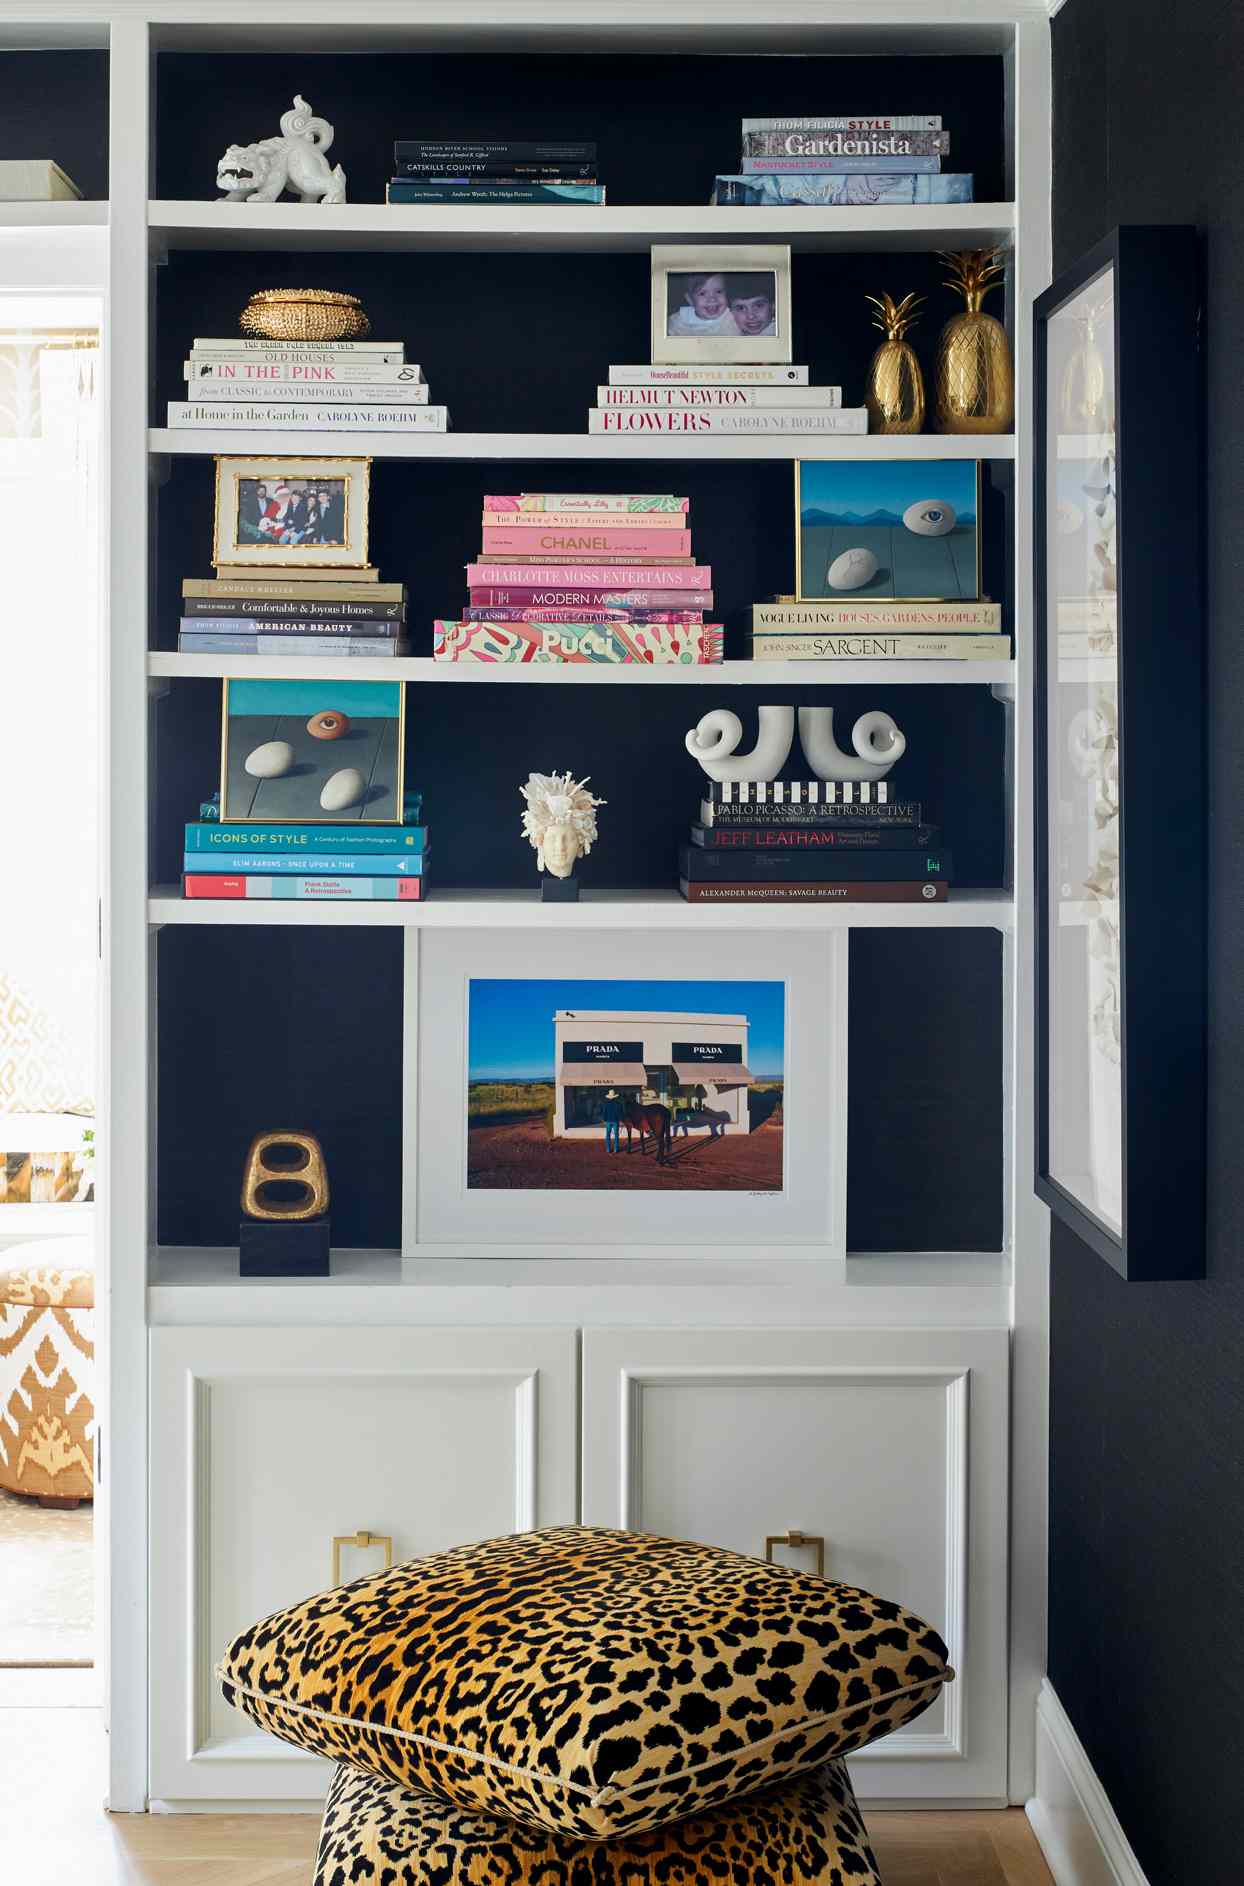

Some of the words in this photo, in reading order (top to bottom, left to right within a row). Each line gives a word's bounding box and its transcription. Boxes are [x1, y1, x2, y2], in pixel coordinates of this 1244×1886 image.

[848, 120, 892, 130] STYLE
[784, 133, 912, 156] Gardenista
[265, 352, 288, 362] OLD
[292, 353, 336, 363] HOUSES
[217, 365, 236, 378] IN
[244, 365, 281, 379] THE
[292, 366, 336, 380] PINK
[220, 387, 262, 397] CLASSIC
[272, 387, 354, 398] CONTEMPORARY
[606, 390, 676, 404] HELMUT
[680, 390, 747, 405] NEWTON
[181, 410, 192, 420] at
[195, 408, 230, 420] Home
[232, 408, 243, 420] in
[246, 408, 265, 421] the
[267, 408, 309, 421] Garden
[317, 412, 374, 422] CAROLYNE
[377, 412, 417, 424] BOEHM
[602, 413, 711, 431] FLOWERS
[720, 415, 785, 428] CAROLYNE
[791, 416, 838, 429] BOEHM
[540, 536, 611, 550] CHANEL
[481, 570, 561, 583] CHARLOTTE
[563, 571, 600, 583] MOSS
[603, 571, 683, 585] ENTERTAINS
[532, 592, 590, 605] MODERN
[593, 593, 649, 606] MASTERS
[241, 602, 298, 613] Comfortable
[299, 603, 308, 613] &
[309, 603, 340, 616] Joyous
[342, 603, 374, 614] Homes
[759, 613, 795, 624] VOGUE
[796, 613, 835, 624] LIVING
[248, 622, 306, 631] AMERICAN
[310, 623, 353, 632] BEAUTY
[542, 628, 616, 659] Pucci
[813, 639, 902, 655] SARGENT
[717, 805, 754, 815] PABLO
[755, 805, 806, 815] PICASSO:
[808, 805, 817, 815] A
[819, 805, 914, 816] RETROSPECTIVE
[209, 833, 249, 844] ICONS
[250, 834, 266, 844] OF
[270, 834, 309, 845] STYLE
[714, 831, 752, 845] JEFF
[755, 831, 834, 846] LEATHAM
[699, 889, 747, 897] ALEXANDER
[818, 889, 848, 897] BEAUTY
[585, 1045, 620, 1053] PRADA
[693, 1046, 723, 1054] PRADA
